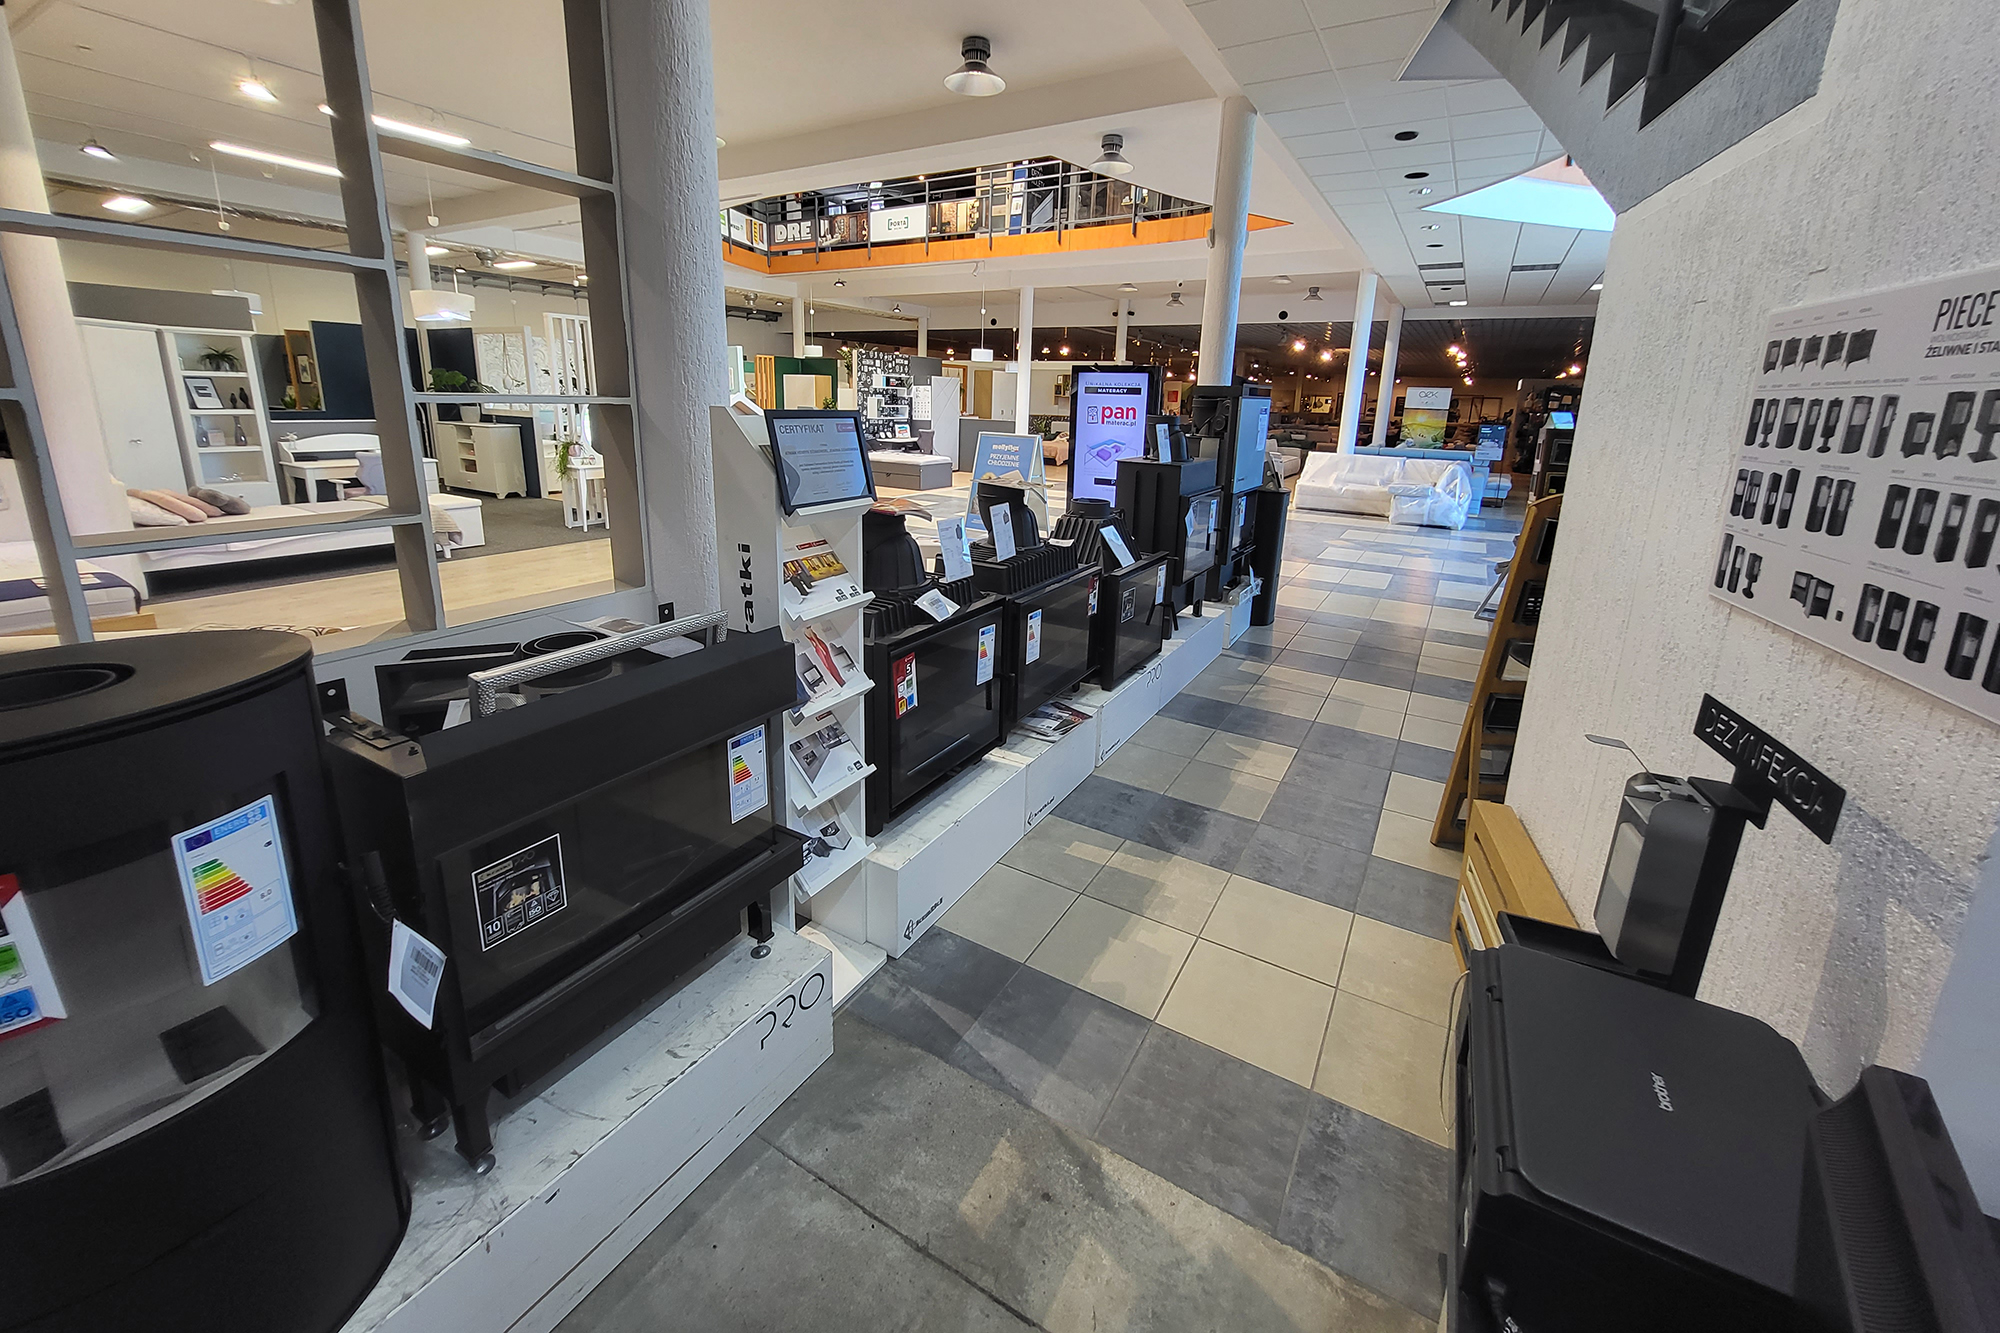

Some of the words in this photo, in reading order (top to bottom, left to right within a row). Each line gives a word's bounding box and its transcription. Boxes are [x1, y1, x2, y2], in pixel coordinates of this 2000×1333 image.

[774, 221, 812, 243] DRE
[1932, 289, 2000, 332] PIECE
[1924, 343, 1973, 358] ŻELIWNE
[1101, 406, 1137, 425] pan
[779, 424, 824, 434] CERTYFIKAT
[990, 453, 1020, 461] PRZYJEMNE
[214, 816, 247, 836] ENERG
[528, 905, 541, 917] ISO
[486, 920, 501, 935] 10
[1651, 1071, 1674, 1111] brother
